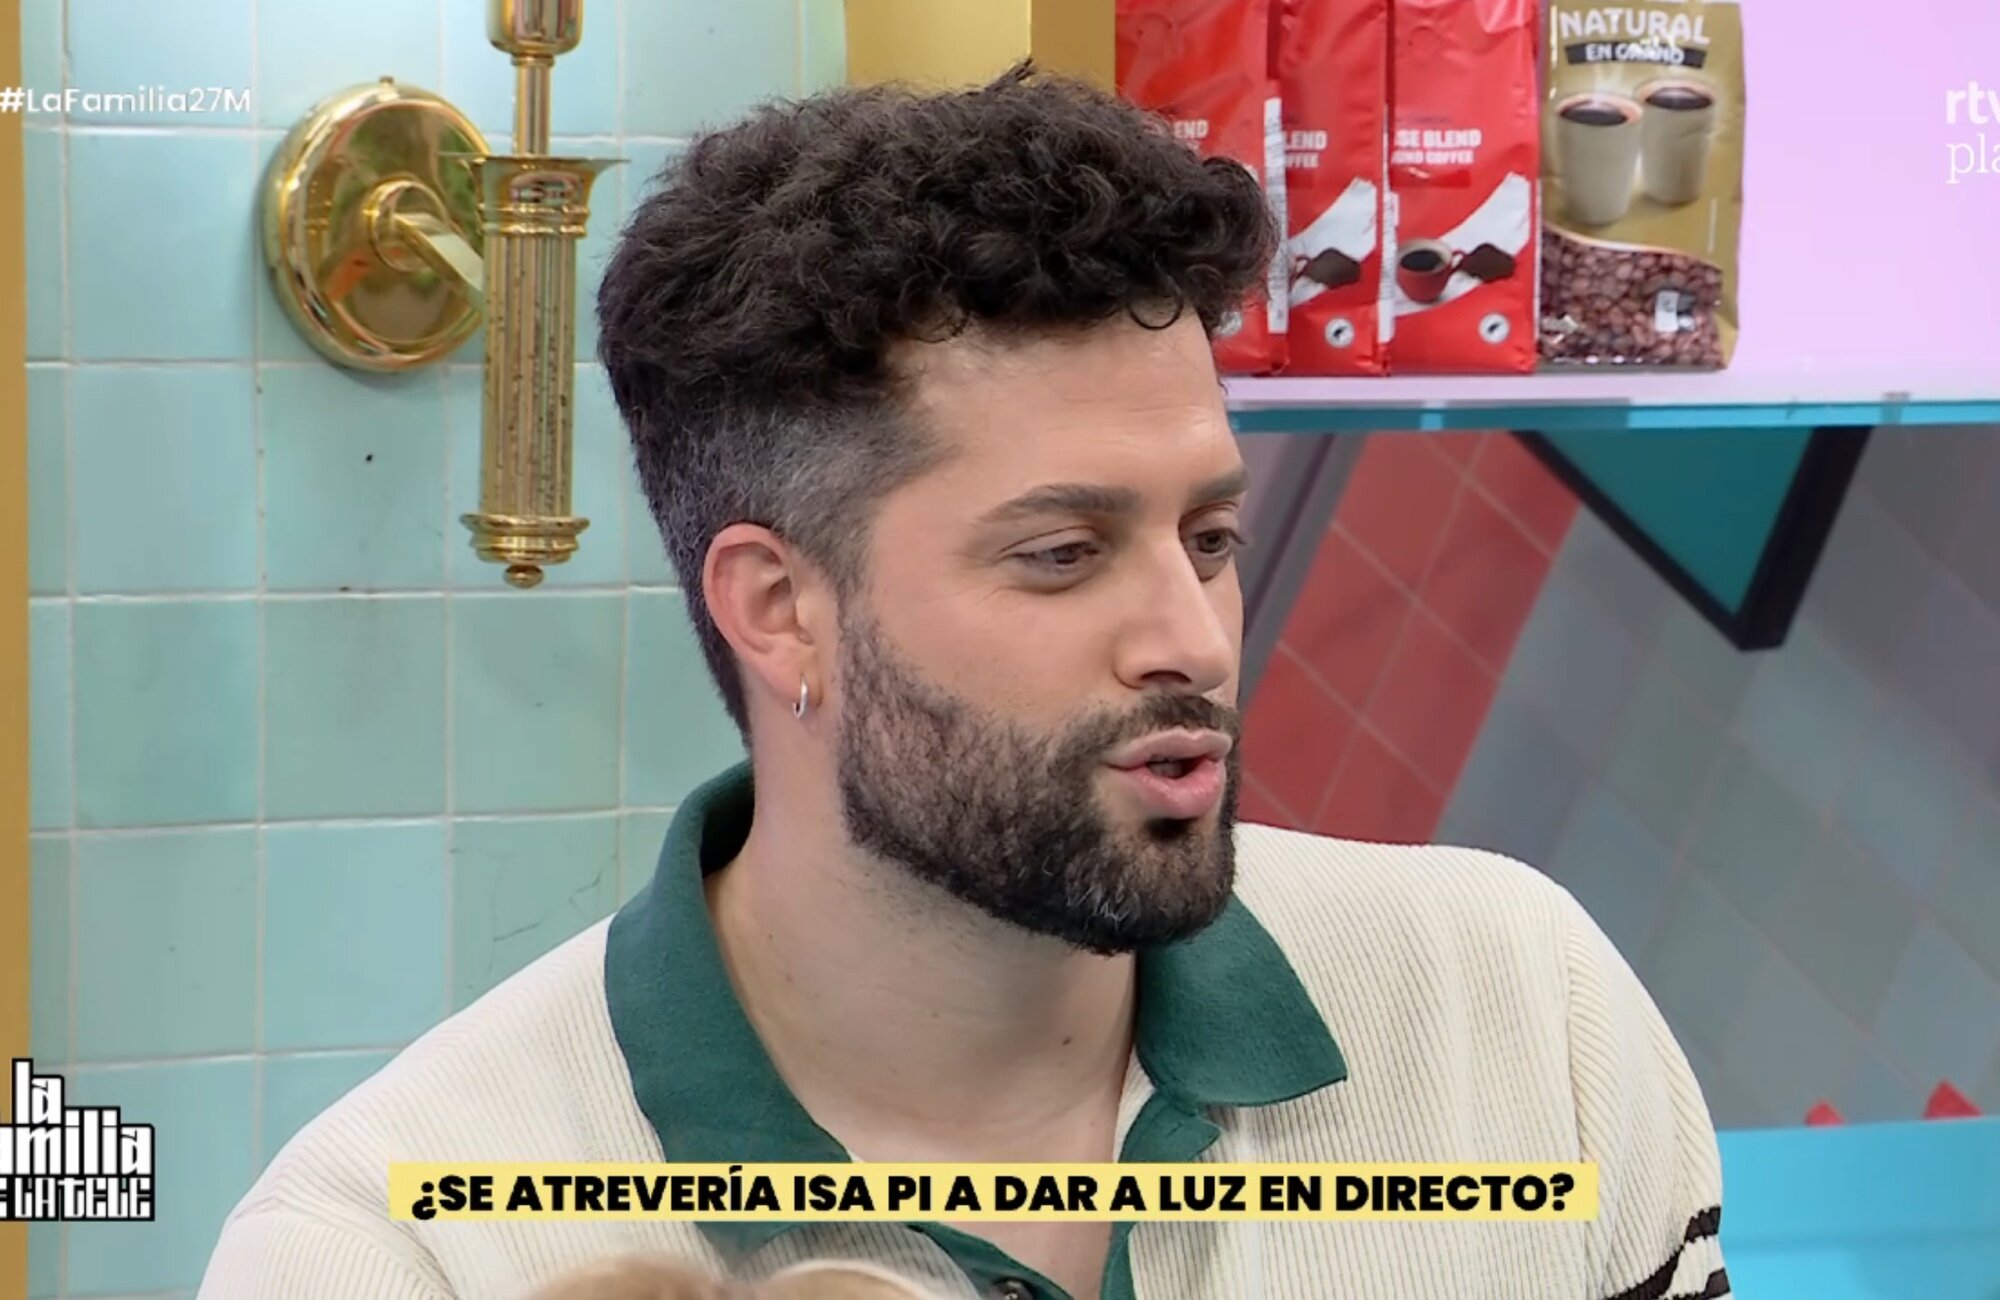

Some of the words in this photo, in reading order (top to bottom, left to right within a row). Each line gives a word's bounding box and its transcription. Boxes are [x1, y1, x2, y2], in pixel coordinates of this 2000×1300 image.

[1559, 7, 1711, 45] NATURAL
[1585, 43, 1612, 61] EN
[1174, 119, 1209, 139] END
[1423, 128, 1482, 149] BLEND
[1425, 149, 1475, 165] COFFEE
